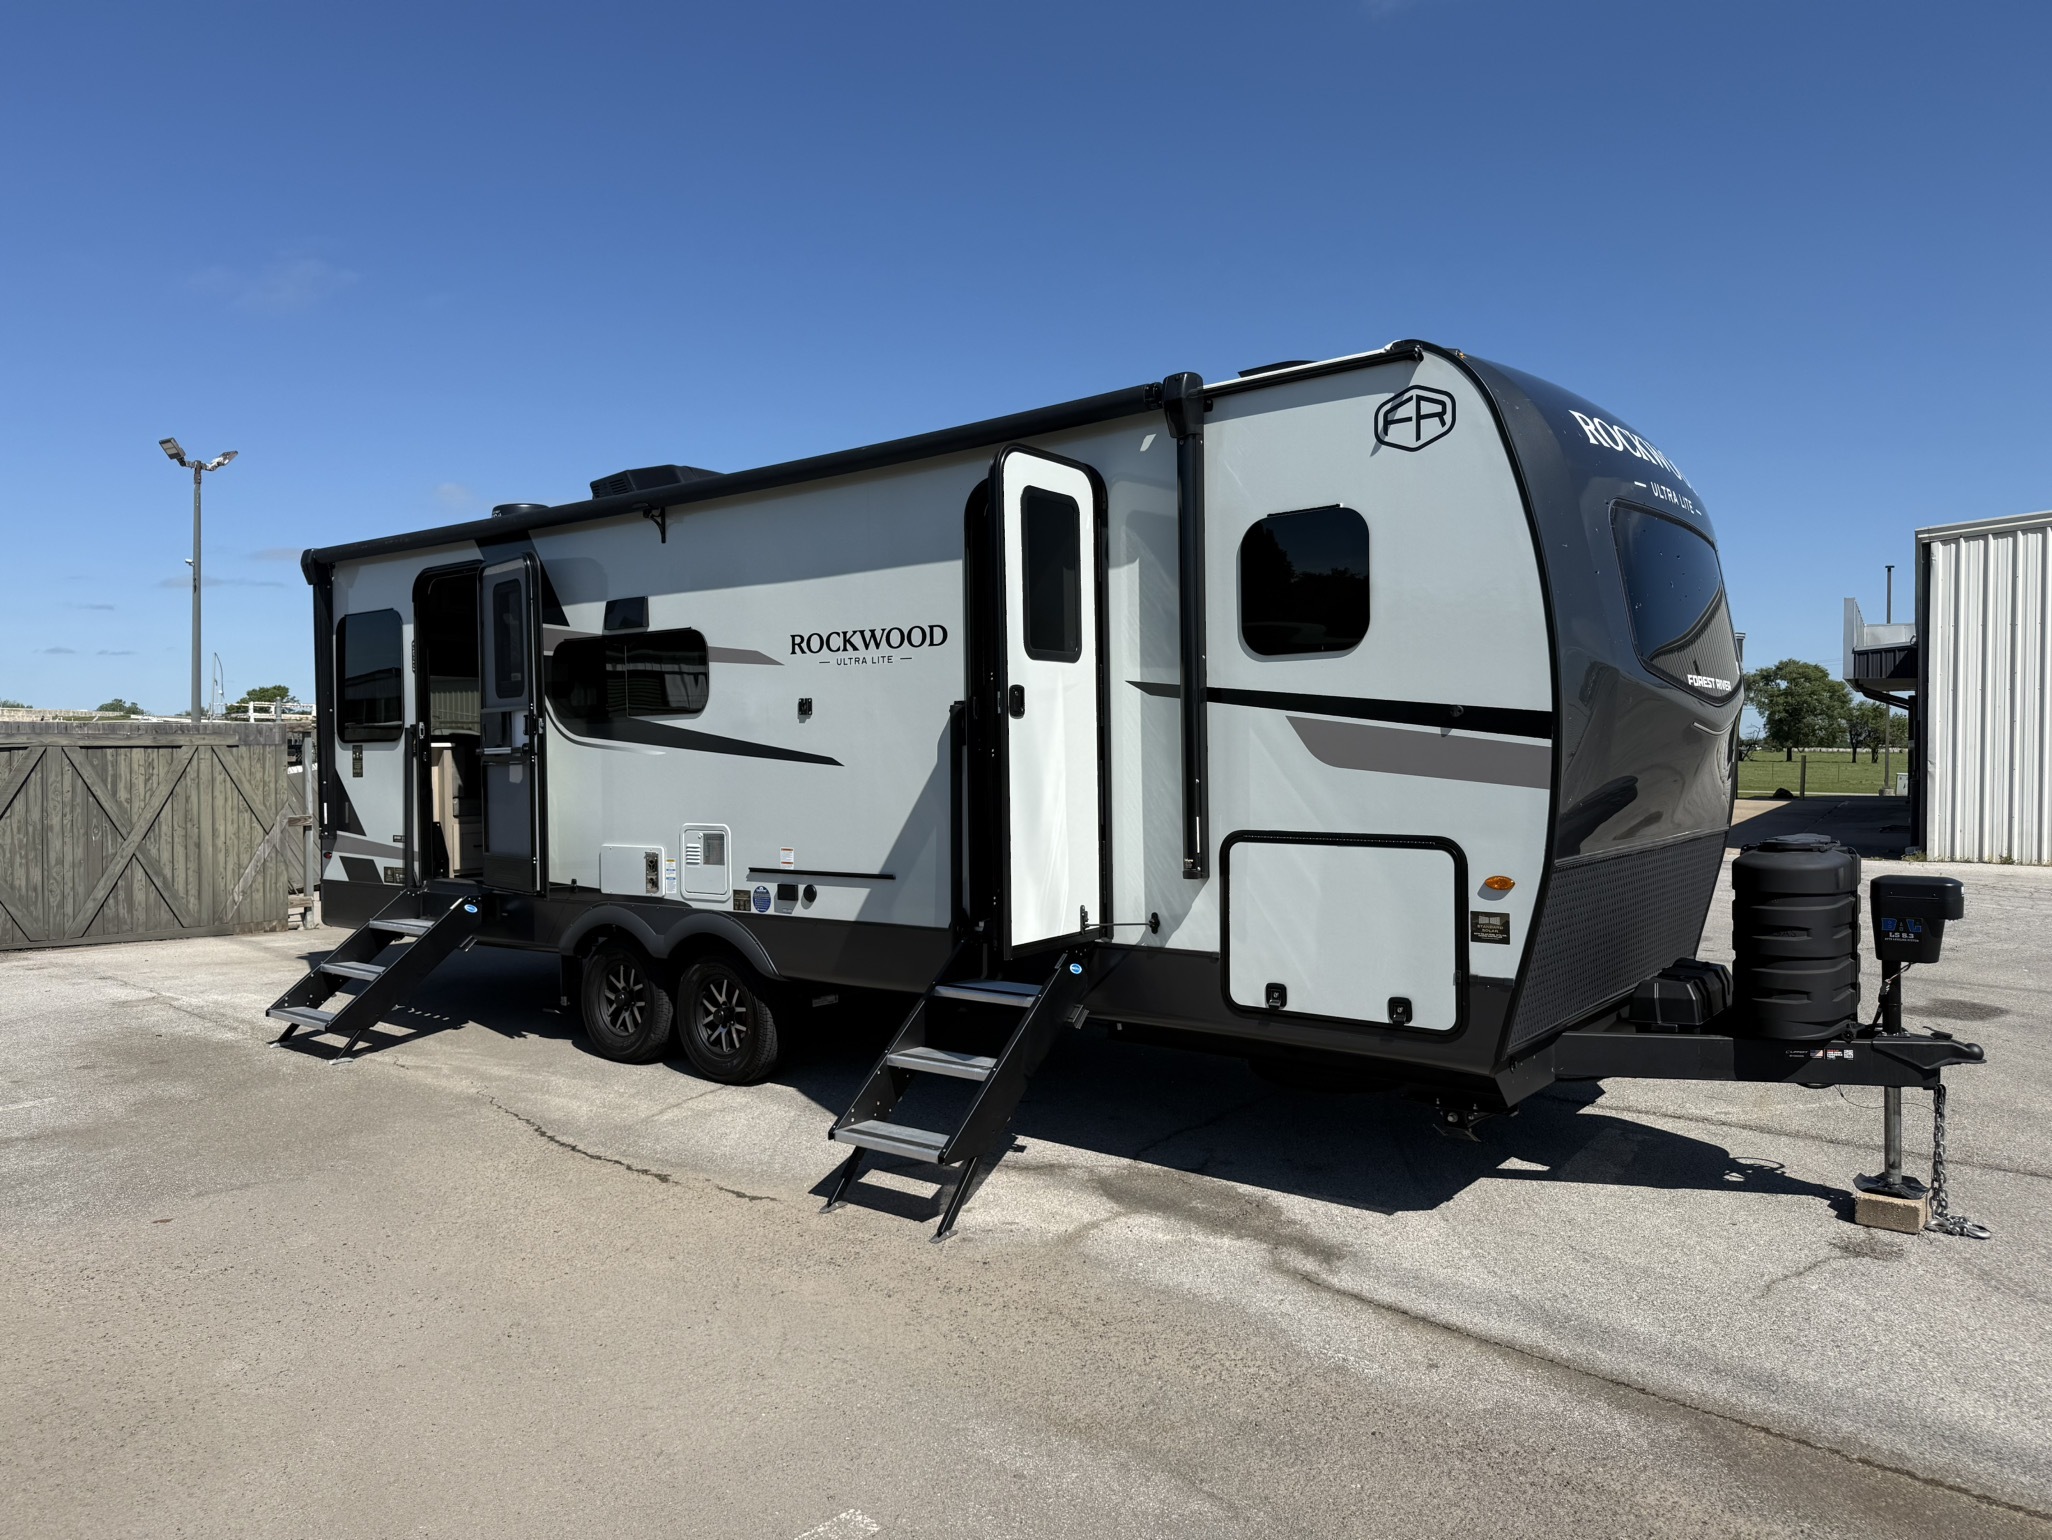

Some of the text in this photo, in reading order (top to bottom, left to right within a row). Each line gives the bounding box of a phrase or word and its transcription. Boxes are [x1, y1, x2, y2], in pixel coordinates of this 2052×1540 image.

[1650, 481, 1695, 514] ULTRA LITE
[790, 624, 948, 655] ROCKWOOD
[836, 655, 894, 666] ULTRA LITE
[1687, 674, 1716, 689] FOREST
